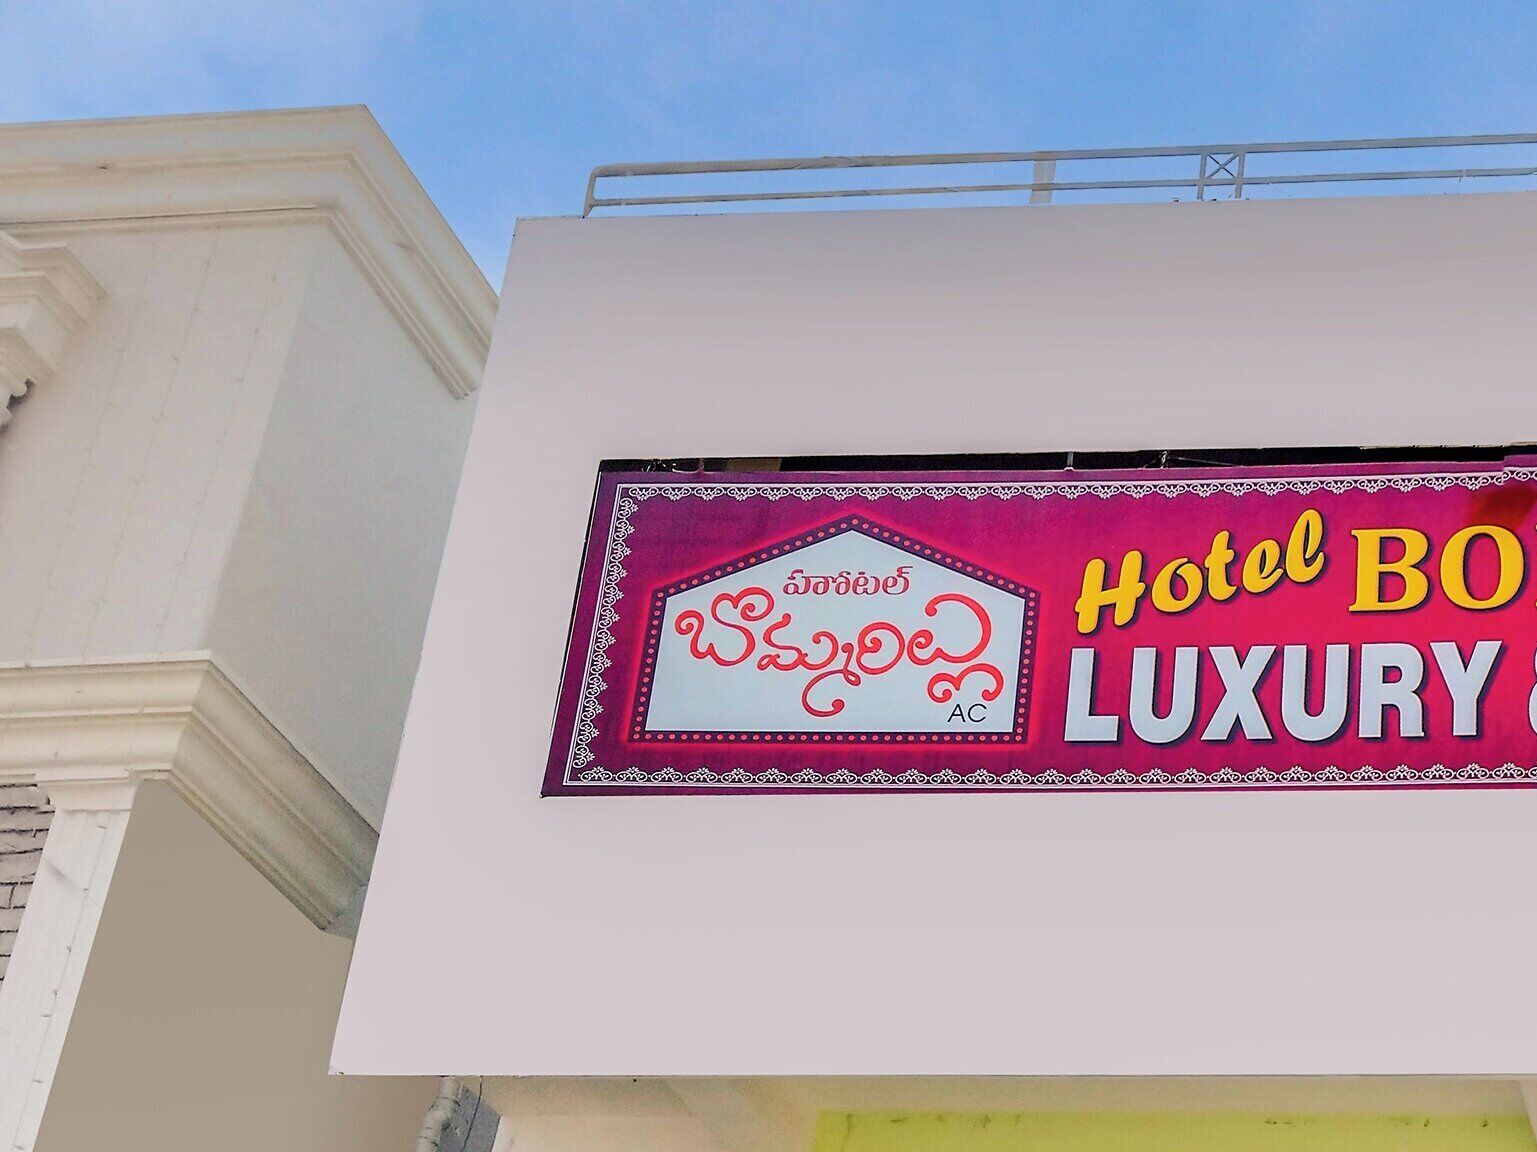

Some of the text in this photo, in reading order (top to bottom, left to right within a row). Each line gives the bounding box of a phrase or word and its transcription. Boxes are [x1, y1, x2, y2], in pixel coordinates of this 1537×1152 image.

[1075, 509, 1326, 635] Hotel
[947, 702, 988, 723] AC
[1063, 640, 1502, 743] LUXURY
